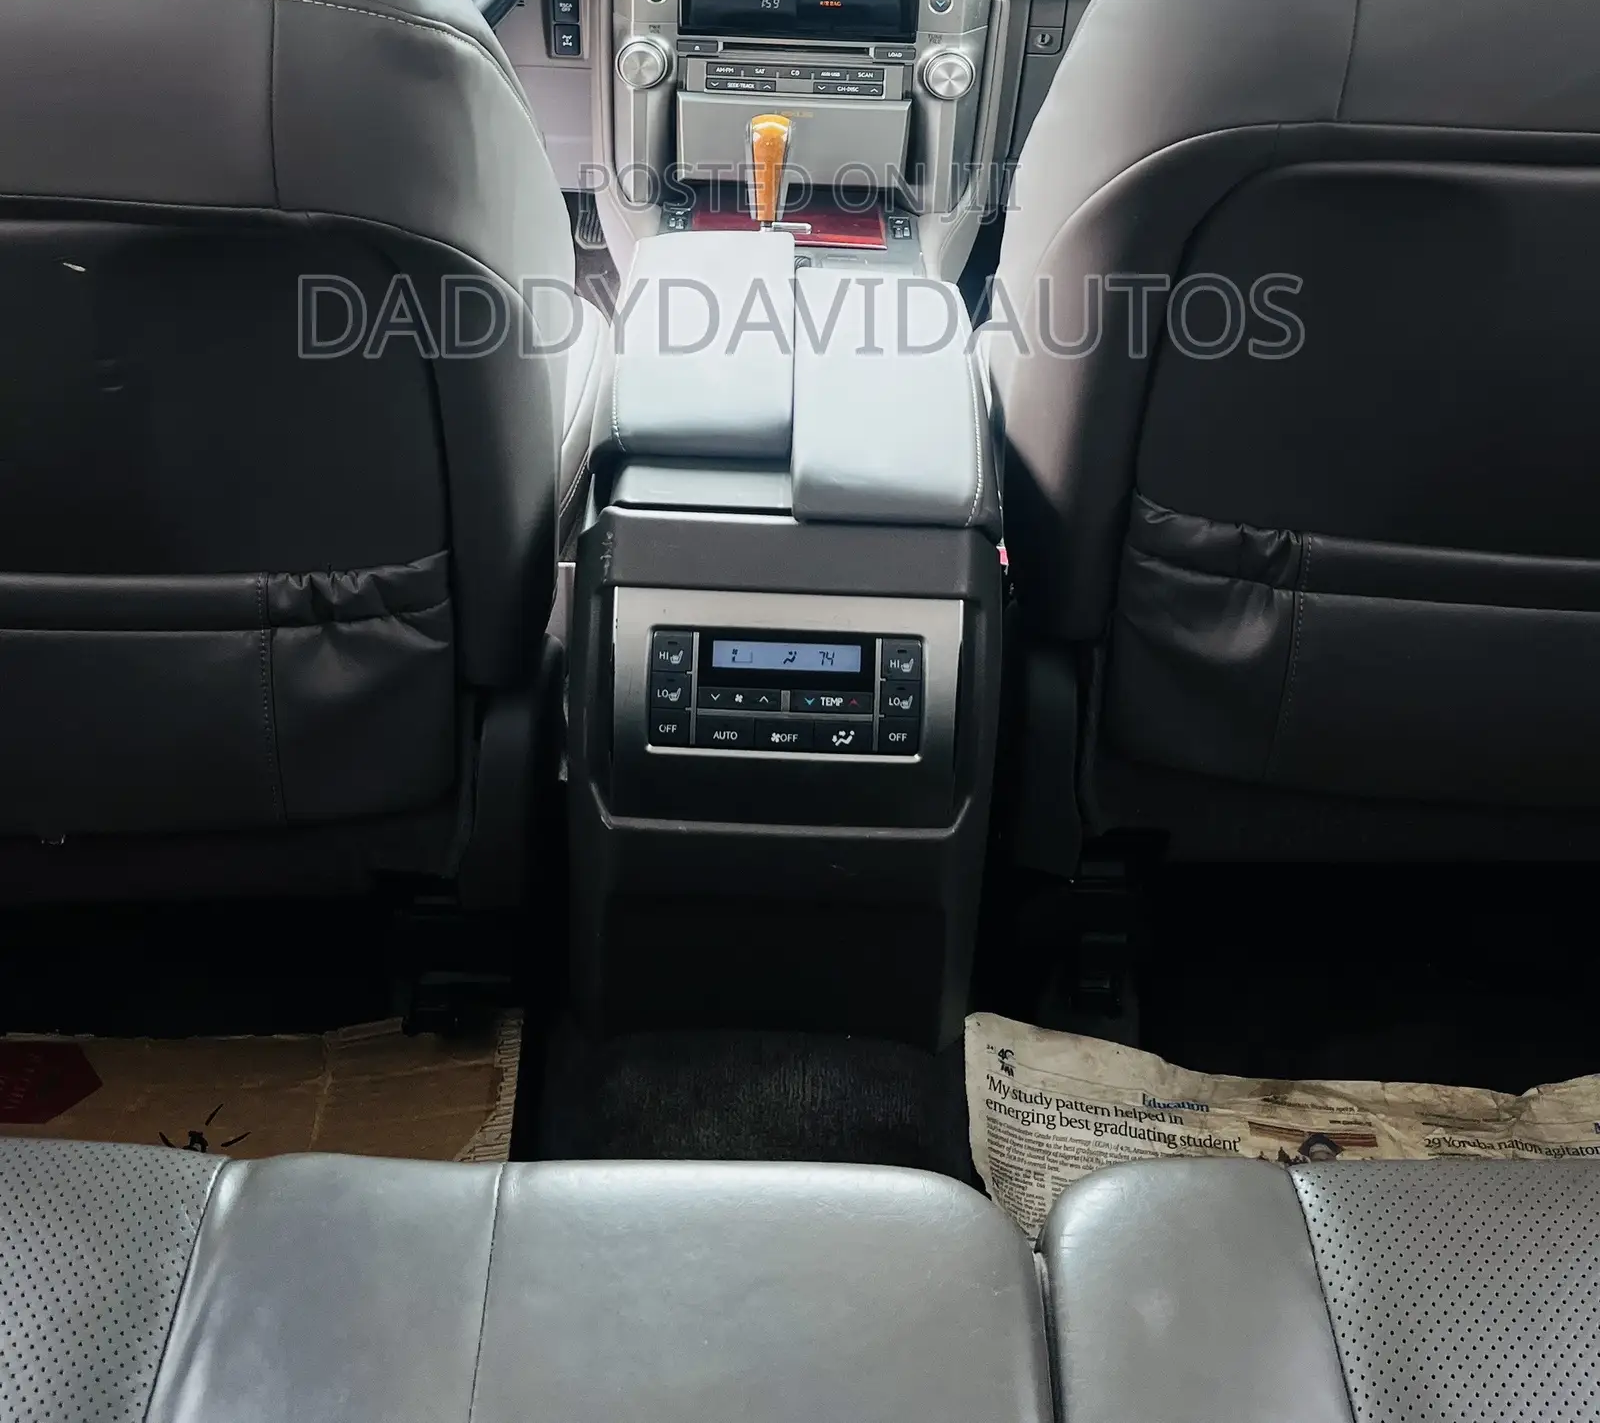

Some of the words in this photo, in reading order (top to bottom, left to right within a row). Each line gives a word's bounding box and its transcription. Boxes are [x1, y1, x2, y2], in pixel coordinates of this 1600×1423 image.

[659, 651, 669, 660] HI
[819, 651, 835, 666] 74
[889, 659, 900, 668] HI
[657, 689, 669, 698] LO
[820, 696, 843, 706] TEMP
[888, 697, 900, 706] LO
[658, 724, 677, 733] OFF
[713, 731, 738, 740] AUTO
[780, 733, 798, 742] OFF
[888, 732, 907, 741] OFF
[1011, 1086, 1053, 1109] study
[1055, 1095, 1111, 1117] pattern
[1113, 1103, 1166, 1127] helped
[1168, 1111, 1185, 1126] in
[1142, 1092, 1210, 1113] Education
[985, 1097, 1056, 1130] emerging
[1059, 1110, 1092, 1131] best
[1093, 1119, 1178, 1150] graduating
[1179, 1132, 1241, 1153] student’
[1424, 1137, 1441, 1149] 29
[1442, 1136, 1495, 1151] Yoruba
[1497, 1138, 1543, 1154] nation
